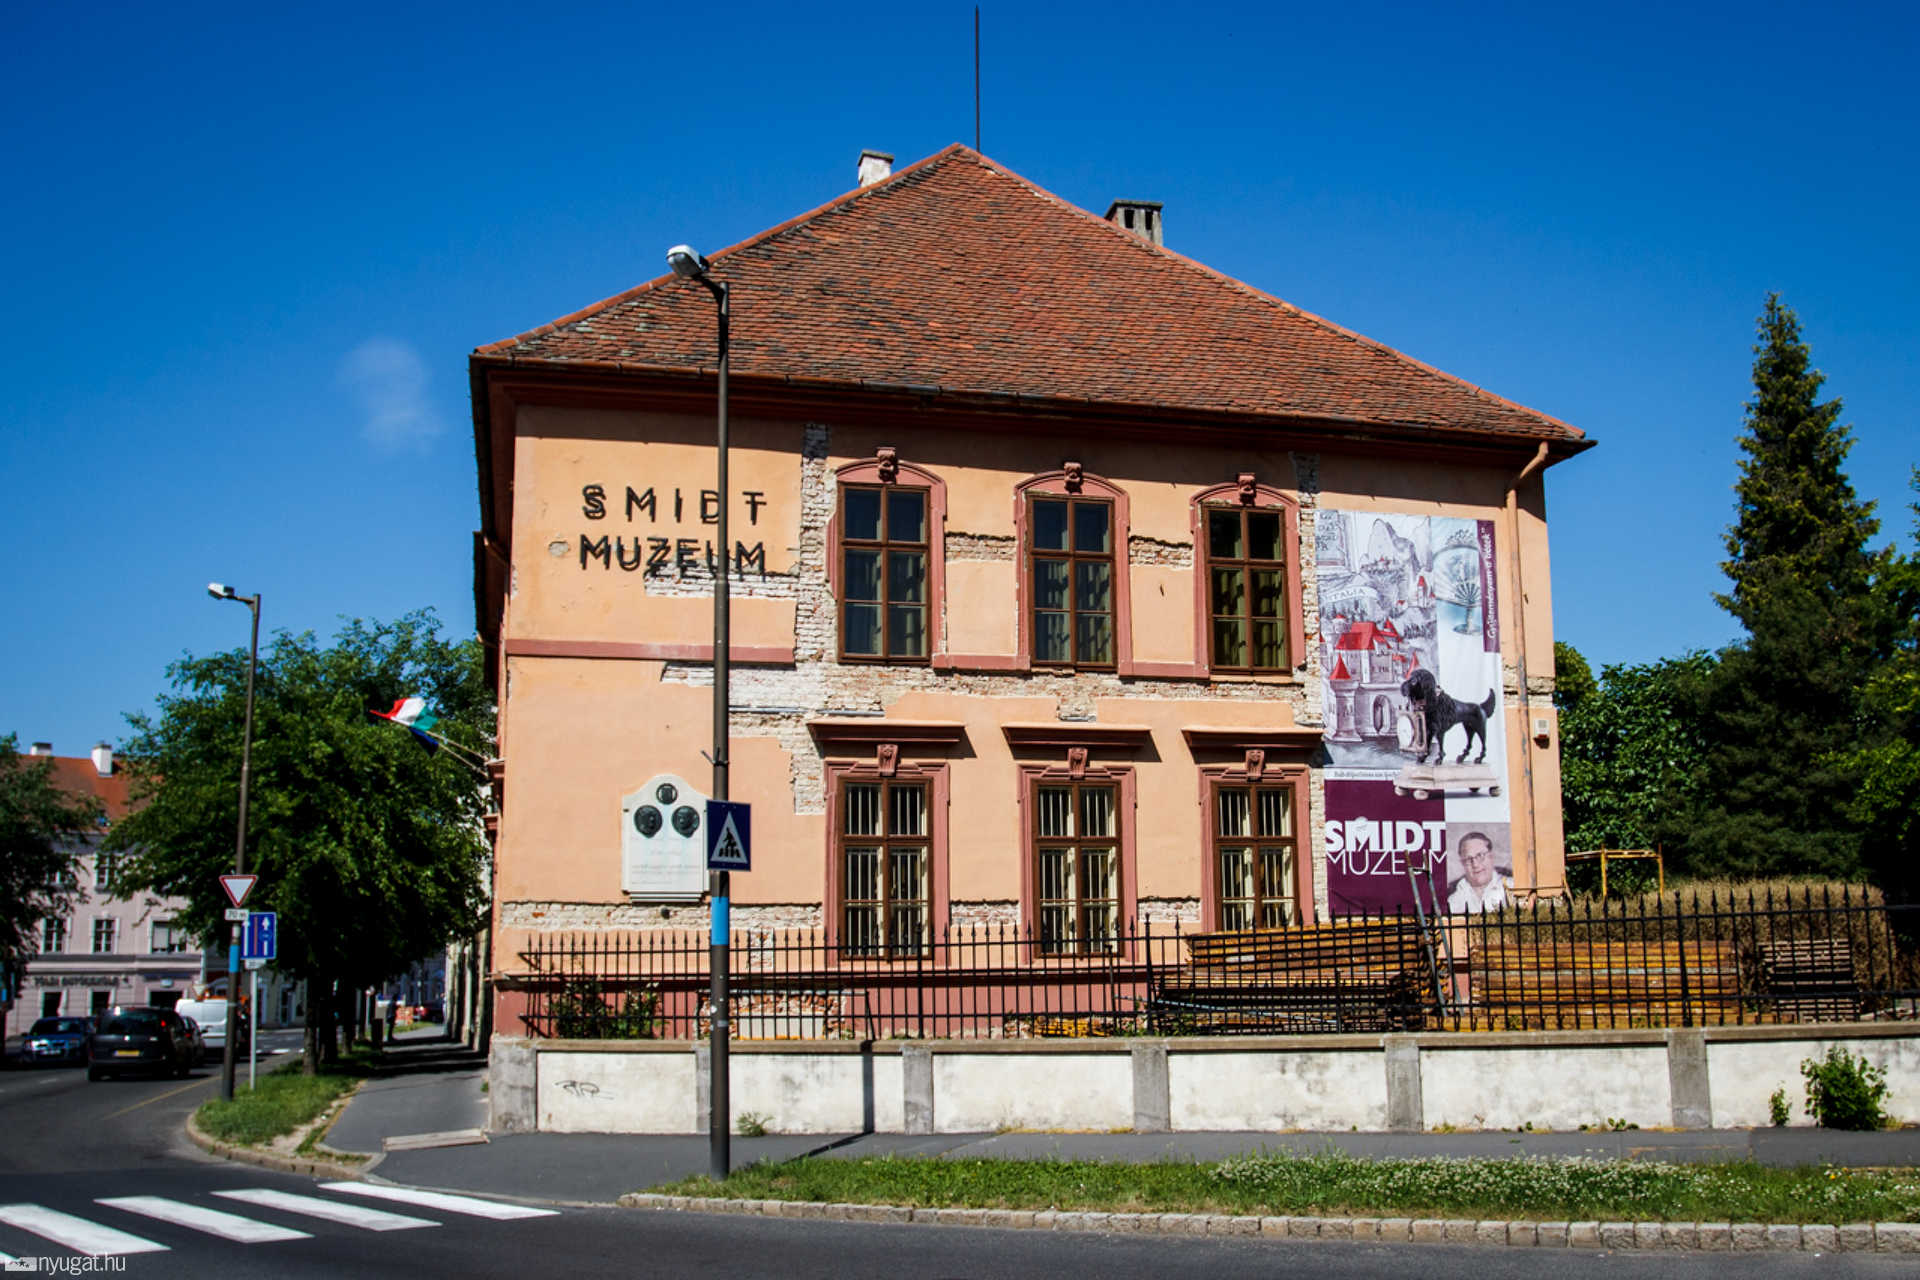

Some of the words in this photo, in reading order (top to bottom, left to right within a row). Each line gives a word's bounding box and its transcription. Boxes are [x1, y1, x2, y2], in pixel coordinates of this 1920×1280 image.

[582, 484, 767, 525] SMIDT
[580, 534, 766, 578] MUZEUM
[1325, 819, 1447, 852] SMIDT
[1326, 849, 1447, 875] MUZEUM
